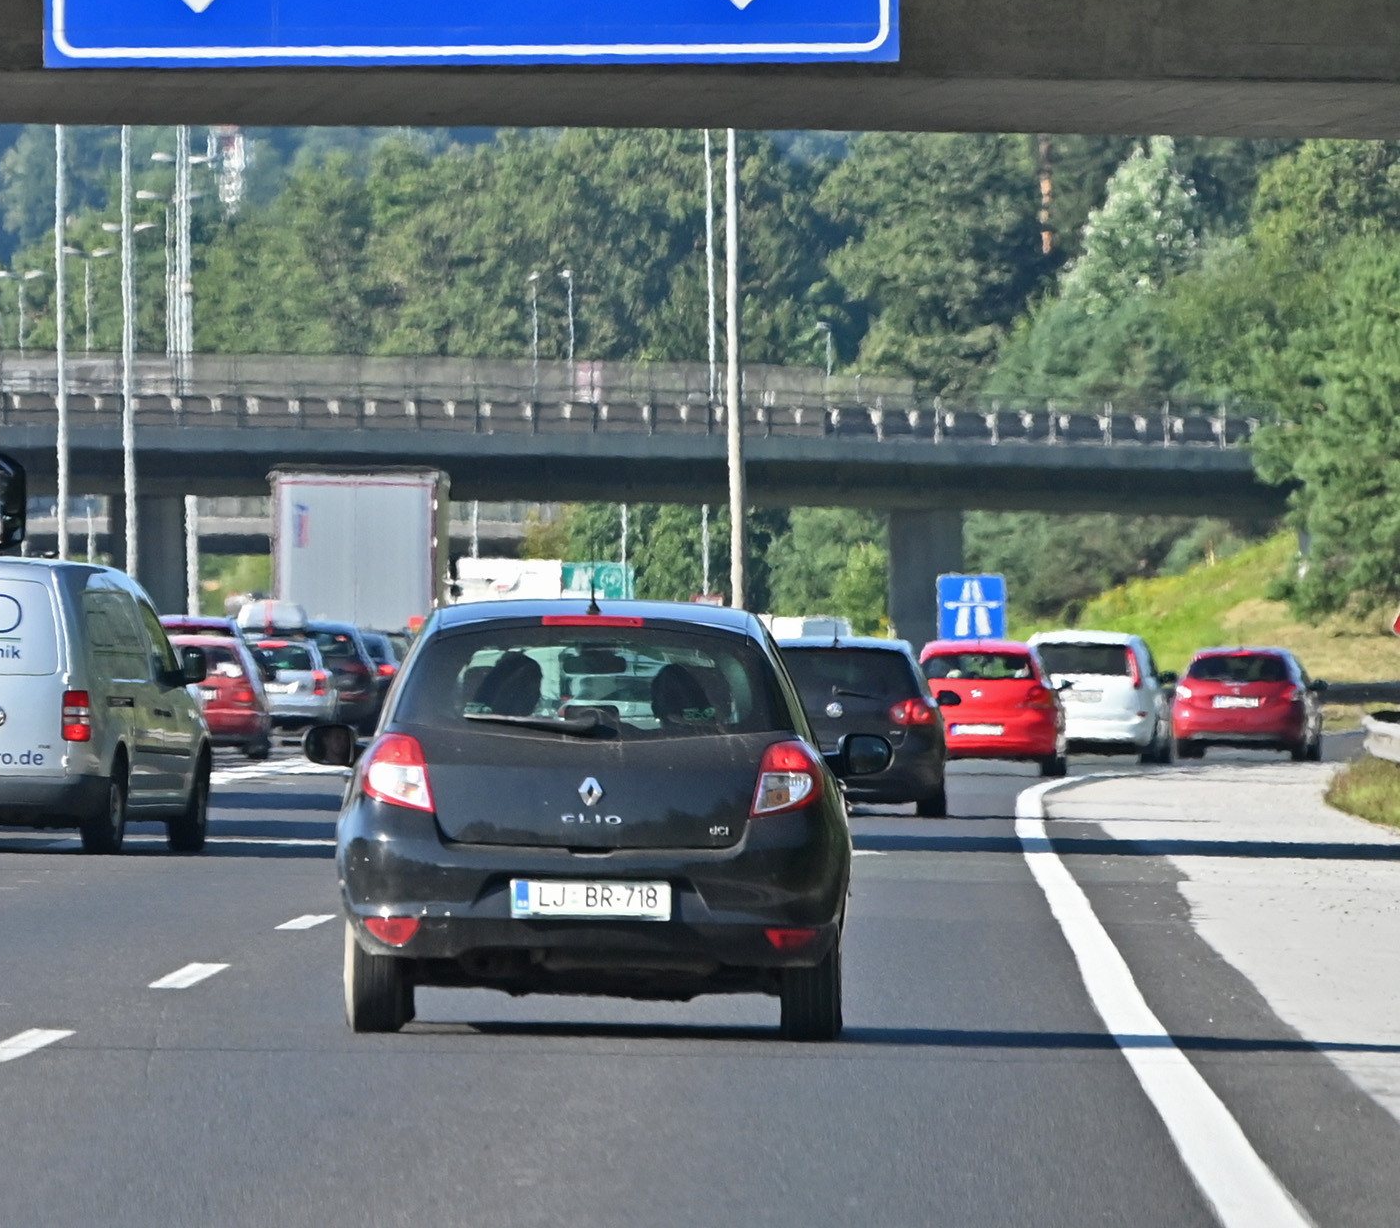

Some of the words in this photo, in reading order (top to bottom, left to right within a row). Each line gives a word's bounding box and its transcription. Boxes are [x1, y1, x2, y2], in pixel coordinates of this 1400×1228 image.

[561, 813, 622, 825] CLIO
[538, 886, 566, 907] LJ
[585, 886, 658, 909] BR-718
